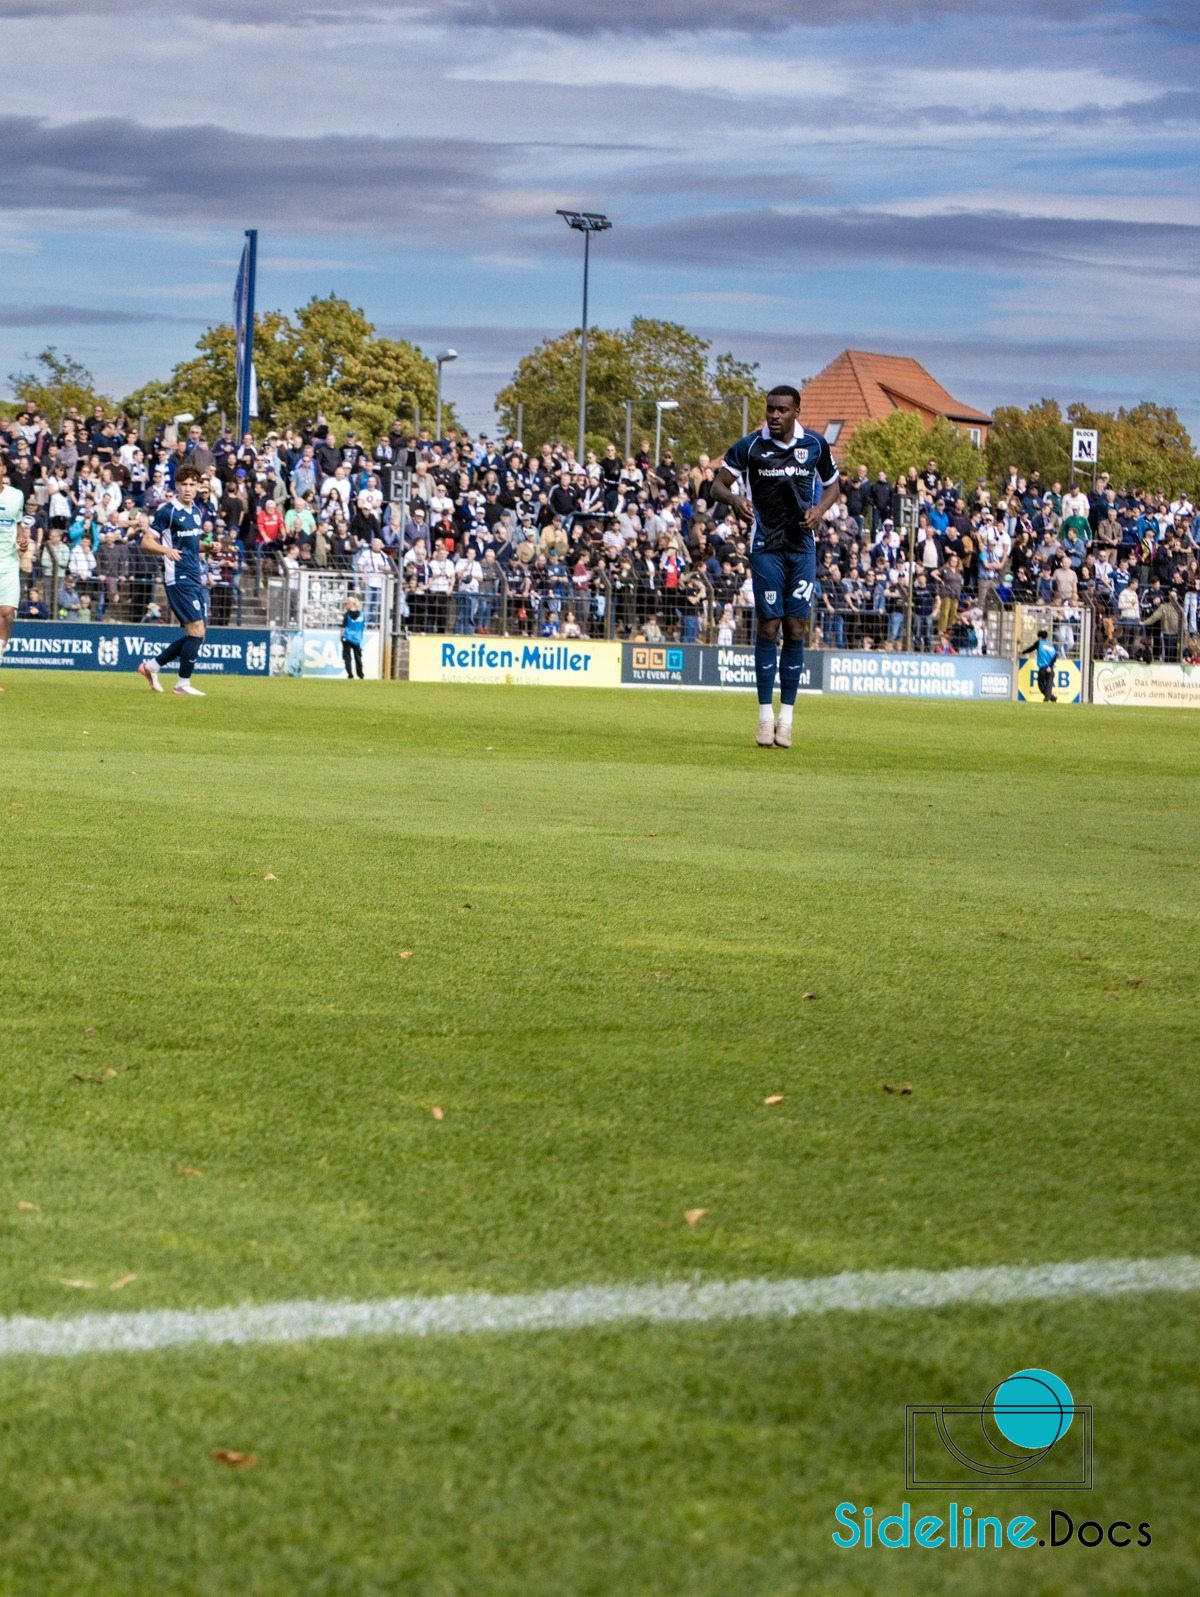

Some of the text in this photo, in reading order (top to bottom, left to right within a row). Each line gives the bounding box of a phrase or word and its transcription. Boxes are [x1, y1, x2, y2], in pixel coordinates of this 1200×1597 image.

[1079, 440, 1091, 457] N
[792, 580, 813, 602] 24
[303, 639, 344, 669] SA
[831, 657, 955, 677] RADIO POTSDAM
[647, 671, 669, 680] EVENT
[830, 675, 850, 691] IM
[1134, 679, 1149, 687] Das
[1104, 679, 1126, 693] KLIMA
[1134, 690, 1147, 698] aus
[1149, 690, 1166, 698] dem
